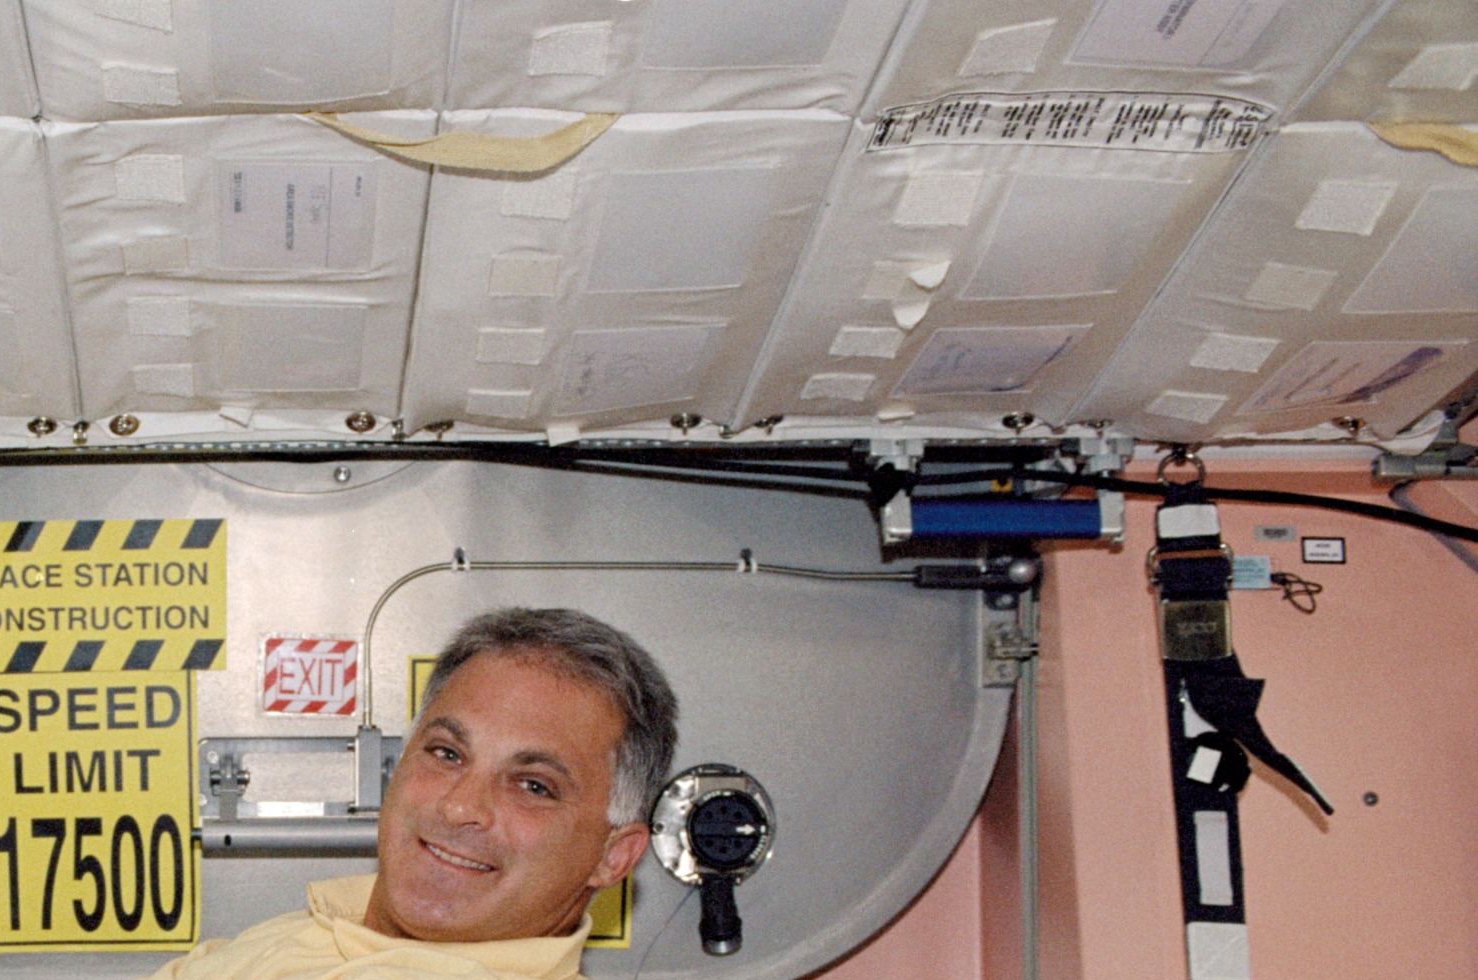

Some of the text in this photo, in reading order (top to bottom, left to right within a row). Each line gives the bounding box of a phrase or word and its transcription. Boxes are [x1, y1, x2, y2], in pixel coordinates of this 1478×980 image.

[73, 561, 210, 588] STATION
[278, 657, 343, 698] EXIT
[14, 750, 161, 795] LIMIT
